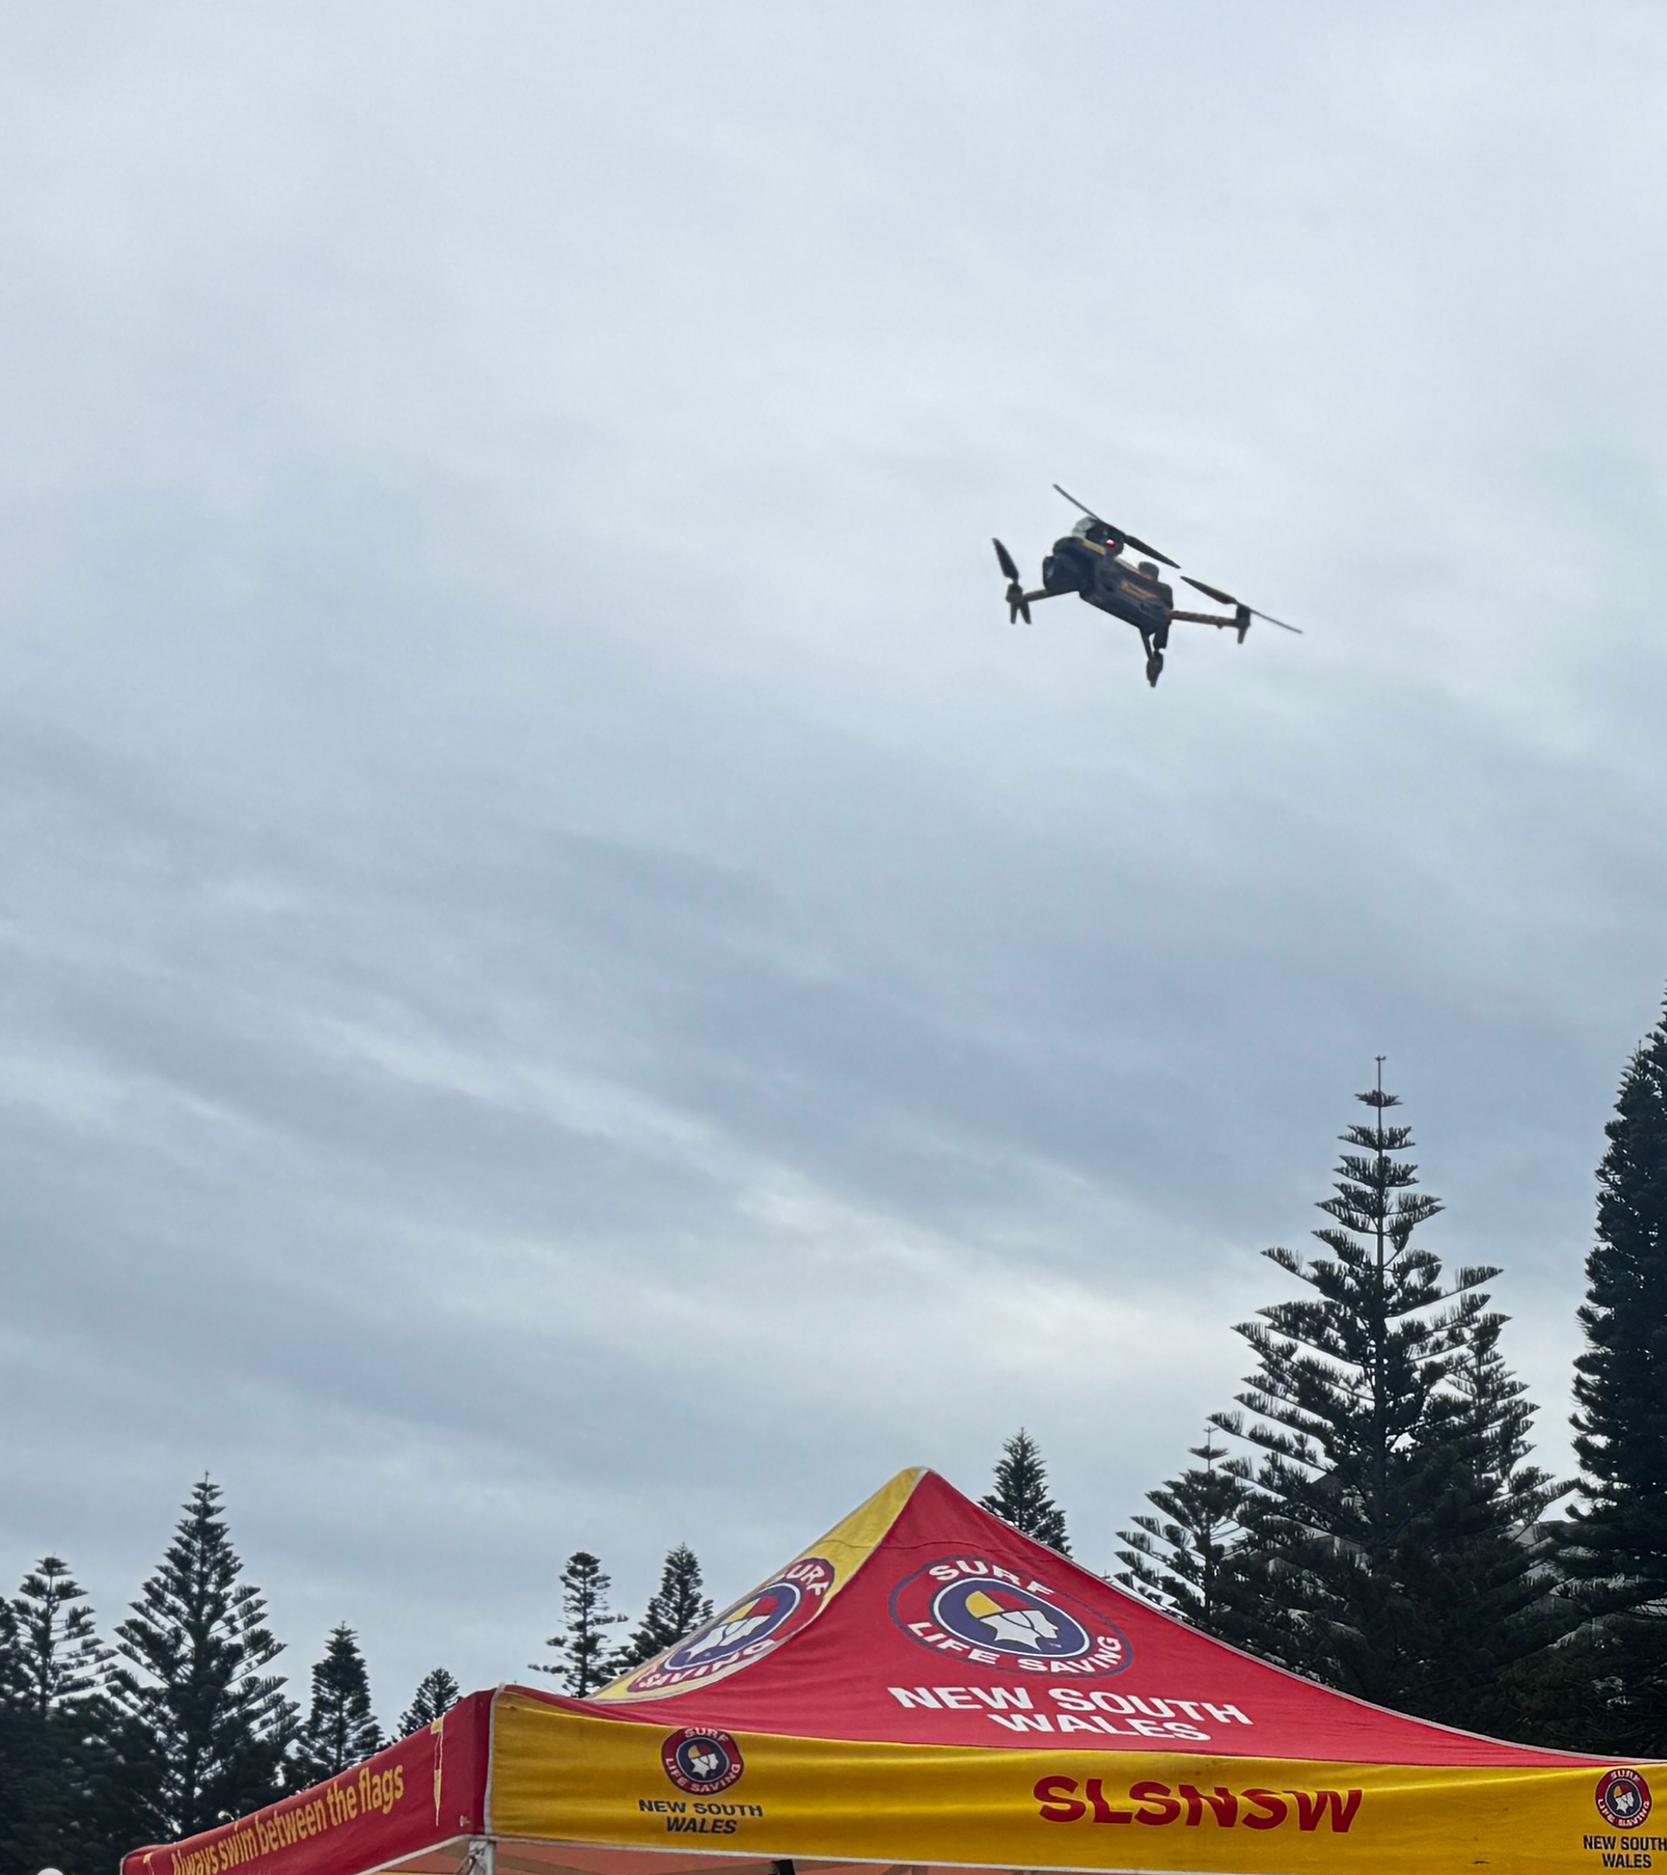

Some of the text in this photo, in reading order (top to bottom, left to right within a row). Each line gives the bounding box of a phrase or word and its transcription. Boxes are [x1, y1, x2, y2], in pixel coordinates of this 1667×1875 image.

[783, 1564, 829, 1596] URF
[928, 1560, 1056, 1596] SURF
[907, 1621, 1122, 1674] LIFE SAVING
[887, 1687, 1253, 1726] NEW SOUTH
[684, 1727, 730, 1743] SURF
[987, 1714, 1212, 1742] WALES
[665, 1758, 741, 1793] LIFE SAVING
[219, 1820, 259, 1871] swim
[255, 1796, 328, 1856] between
[326, 1781, 357, 1827] the
[358, 1764, 405, 1815] flags
[638, 1799, 764, 1817] NEW SOUTH
[1033, 1775, 1363, 1834] SLSNSW
[666, 1816, 738, 1834] WALES
[1583, 1835, 1617, 1850] NEW
[1602, 1853, 1653, 1868] WALES
